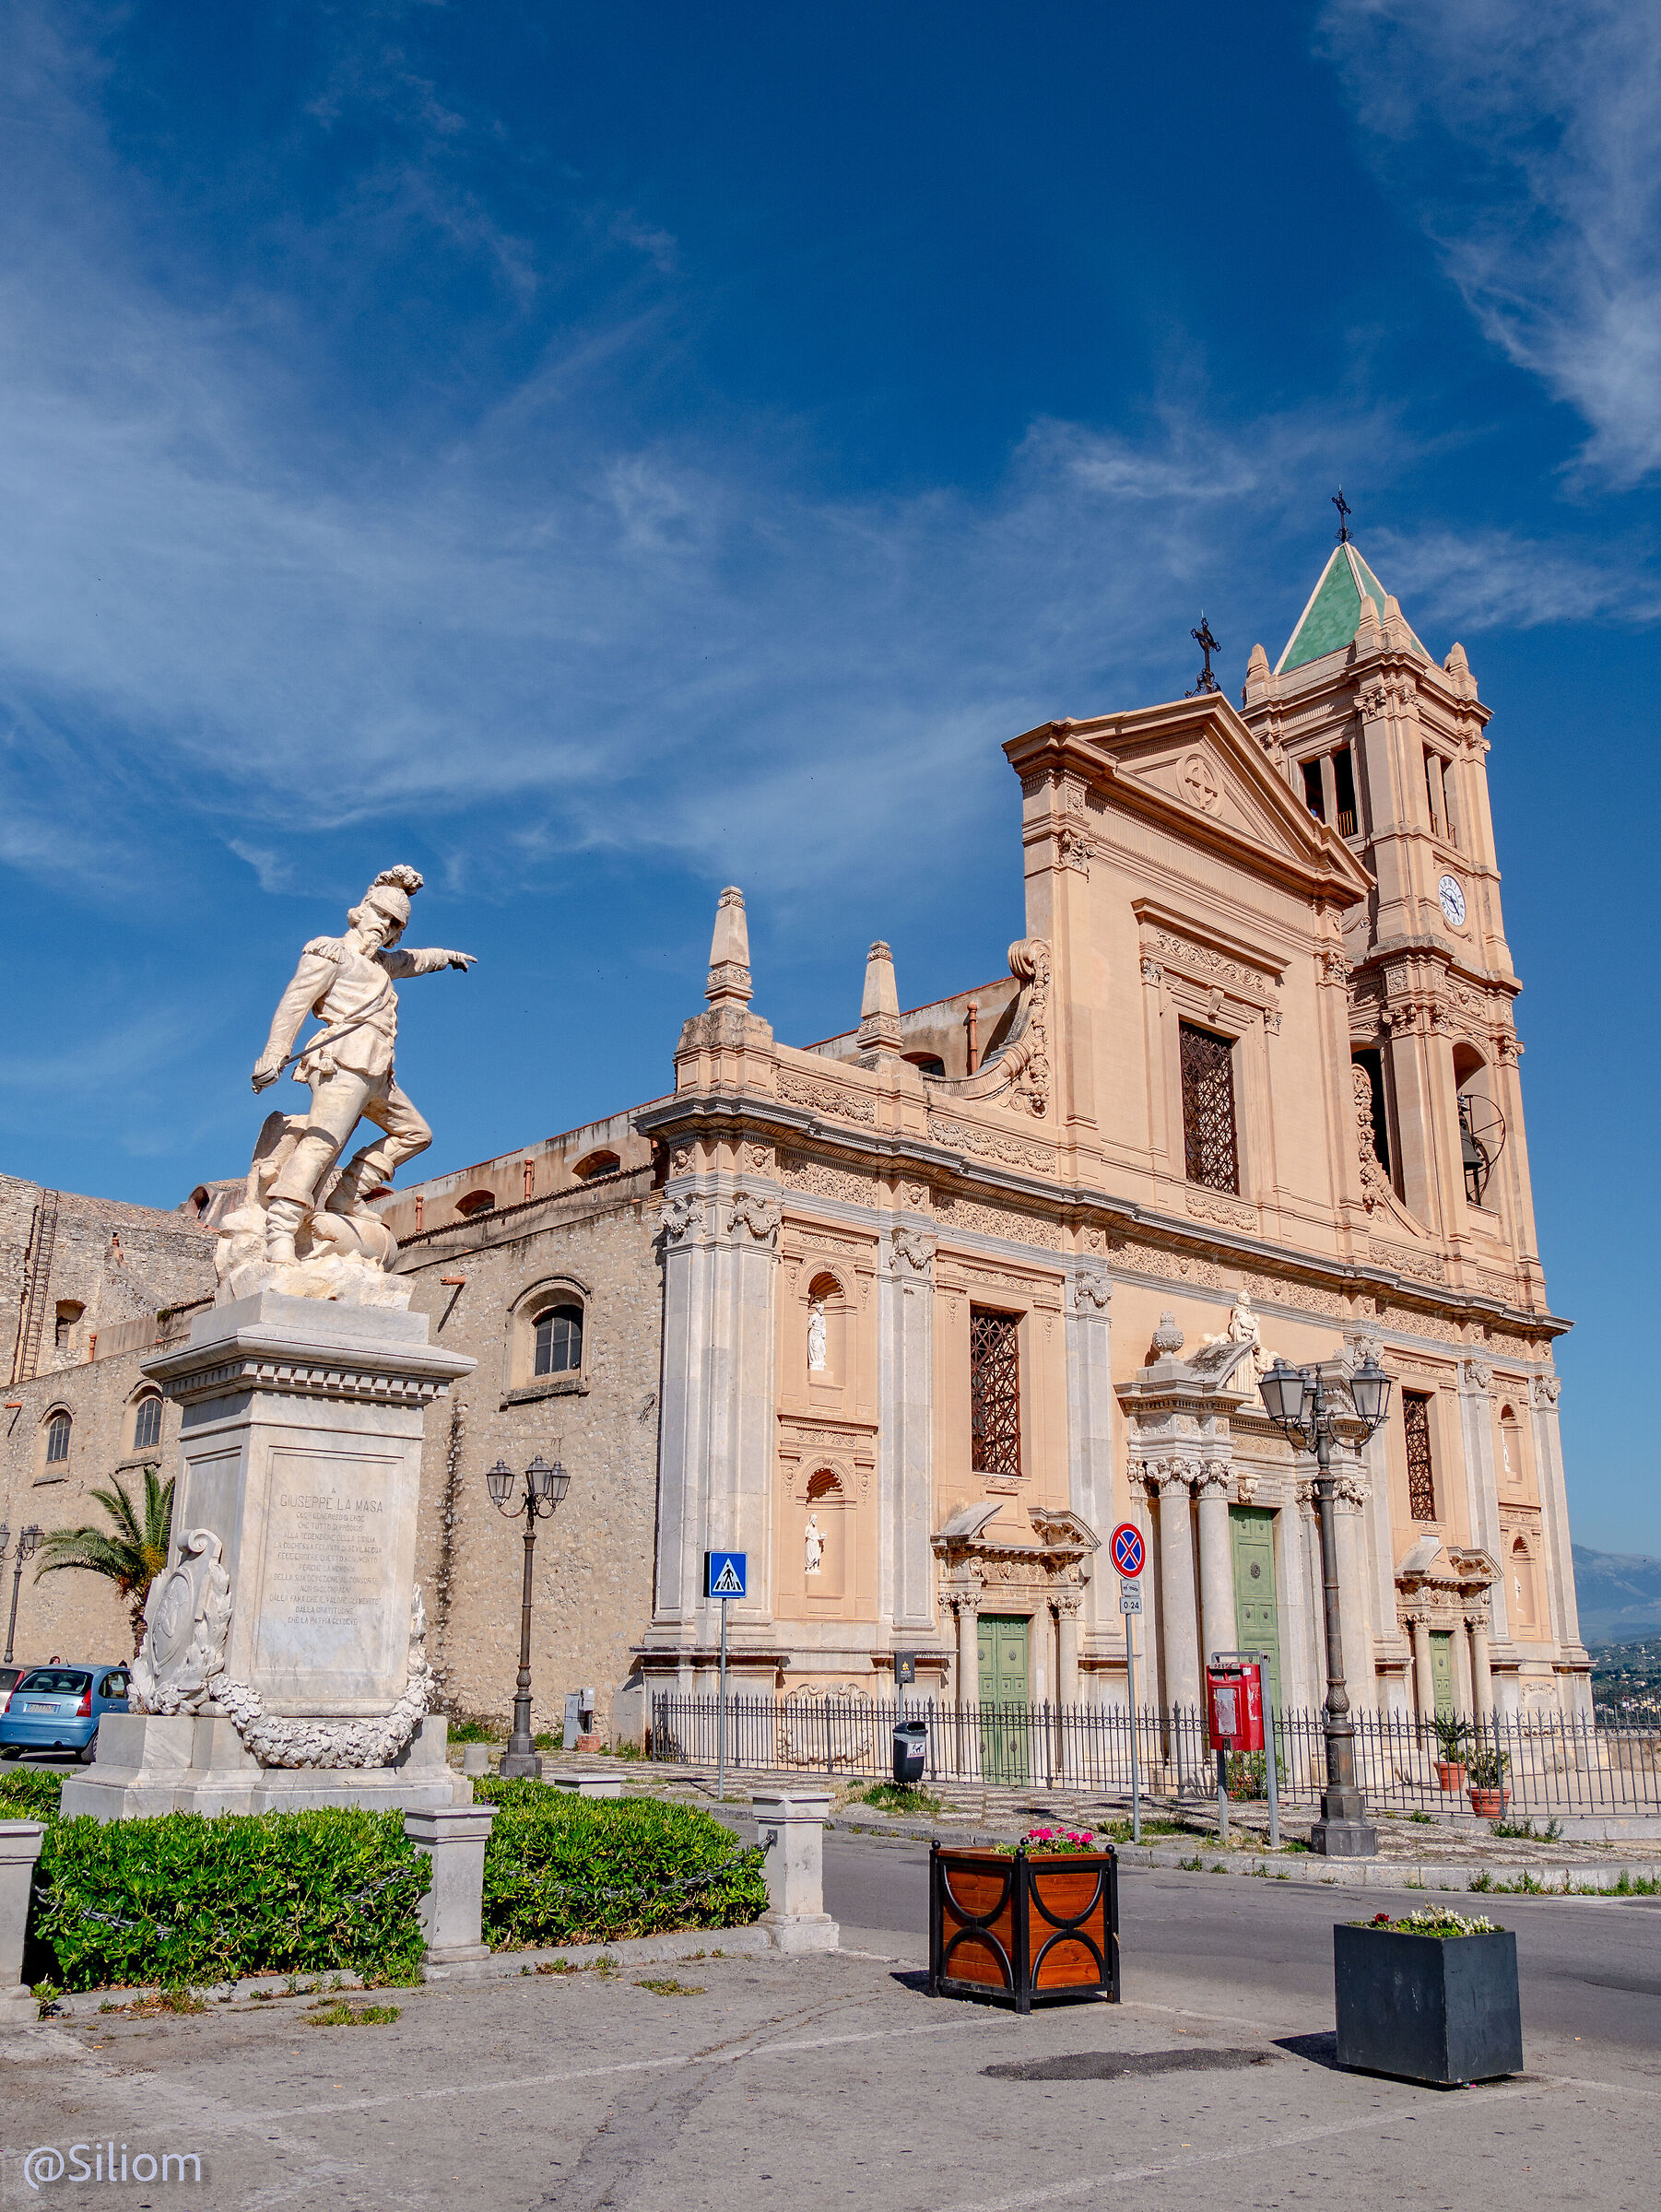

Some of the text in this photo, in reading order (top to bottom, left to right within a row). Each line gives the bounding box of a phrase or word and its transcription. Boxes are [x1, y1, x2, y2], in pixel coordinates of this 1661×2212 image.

[280, 1494, 383, 1512] GIUSEPPE LA MASA
[288, 1616, 300, 1624] CHE
